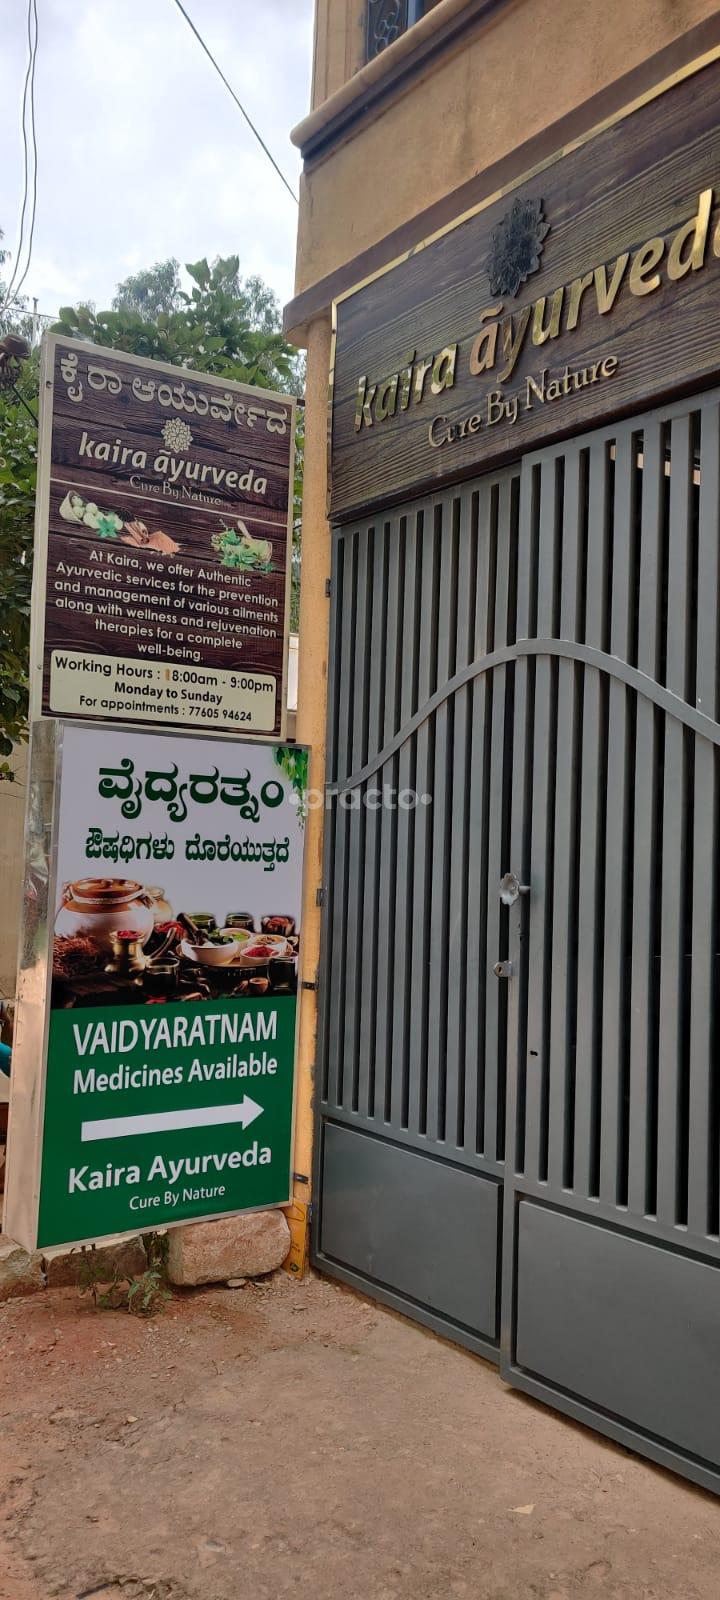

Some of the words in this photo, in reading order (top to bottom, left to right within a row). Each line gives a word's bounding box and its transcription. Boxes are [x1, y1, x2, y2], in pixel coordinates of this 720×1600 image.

[354, 344, 458, 431] kaira
[469, 188, 720, 383] ãyurved
[60, 353, 122, 402] ಕೈರಾ
[132, 376, 287, 434] ಆಯುರ್ವೇದ
[428, 414, 481, 447] Cure
[486, 391, 519, 425] By
[525, 355, 618, 409] Nature
[79, 432, 146, 468] kaira
[154, 449, 267, 494] ãyurveda
[130, 475, 159, 493] Cure
[163, 481, 178, 499] By
[182, 486, 220, 505] Nature
[56, 562, 122, 583] Ayurvedic
[126, 574, 175, 591] services
[179, 581, 194, 594] for
[197, 584, 215, 597] the
[219, 588, 278, 607] prevention
[90, 550, 105, 562] At
[108, 553, 142, 570] Kaira,
[146, 561, 164, 572] we
[168, 564, 194, 577] offer
[198, 568, 251, 587] Authentic
[55, 579, 80, 592] and
[85, 585, 170, 608] management
[174, 597, 186, 608] of
[189, 601, 229, 616] various
[232, 607, 278, 623] ailments
[56, 598, 93, 614] along
[97, 603, 122, 616] with
[126, 608, 177, 624] wellness
[181, 615, 203, 628] and
[207, 619, 277, 638] rejuvenation
[95, 619, 153, 639] therapies
[157, 627, 172, 640] for
[176, 632, 183, 641] a
[188, 633, 242, 650] complete
[137, 643, 203, 663] well-being.
[55, 656, 111, 676] Working
[117, 663, 153, 679] Hours
[231, 677, 273, 693] 9:00pm
[115, 682, 163, 698] Monday
[167, 686, 178, 698] to
[181, 689, 223, 705] Sunday
[80, 696, 97, 707] For
[101, 698, 179, 716] appointments
[189, 707, 219, 718] 77605
[223, 710, 252, 722] 94624
[98, 758, 284, 823] ವೈದ್ಯರತ್ನಂ
[86, 828, 175, 863] ಔಷಧಿಗಳು
[185, 833, 289, 871] ದೊರೆಯುತ್ತದೆ
[73, 1011, 277, 1055] VAIDYARATNAM
[73, 1065, 182, 1094] Medicines
[188, 1052, 277, 1082] Available
[68, 1163, 140, 1193] Kaira
[147, 1141, 272, 1184] Ayurveda
[129, 1192, 160, 1210] Cure
[164, 1191, 179, 1206] By
[182, 1185, 225, 1201] Nature
